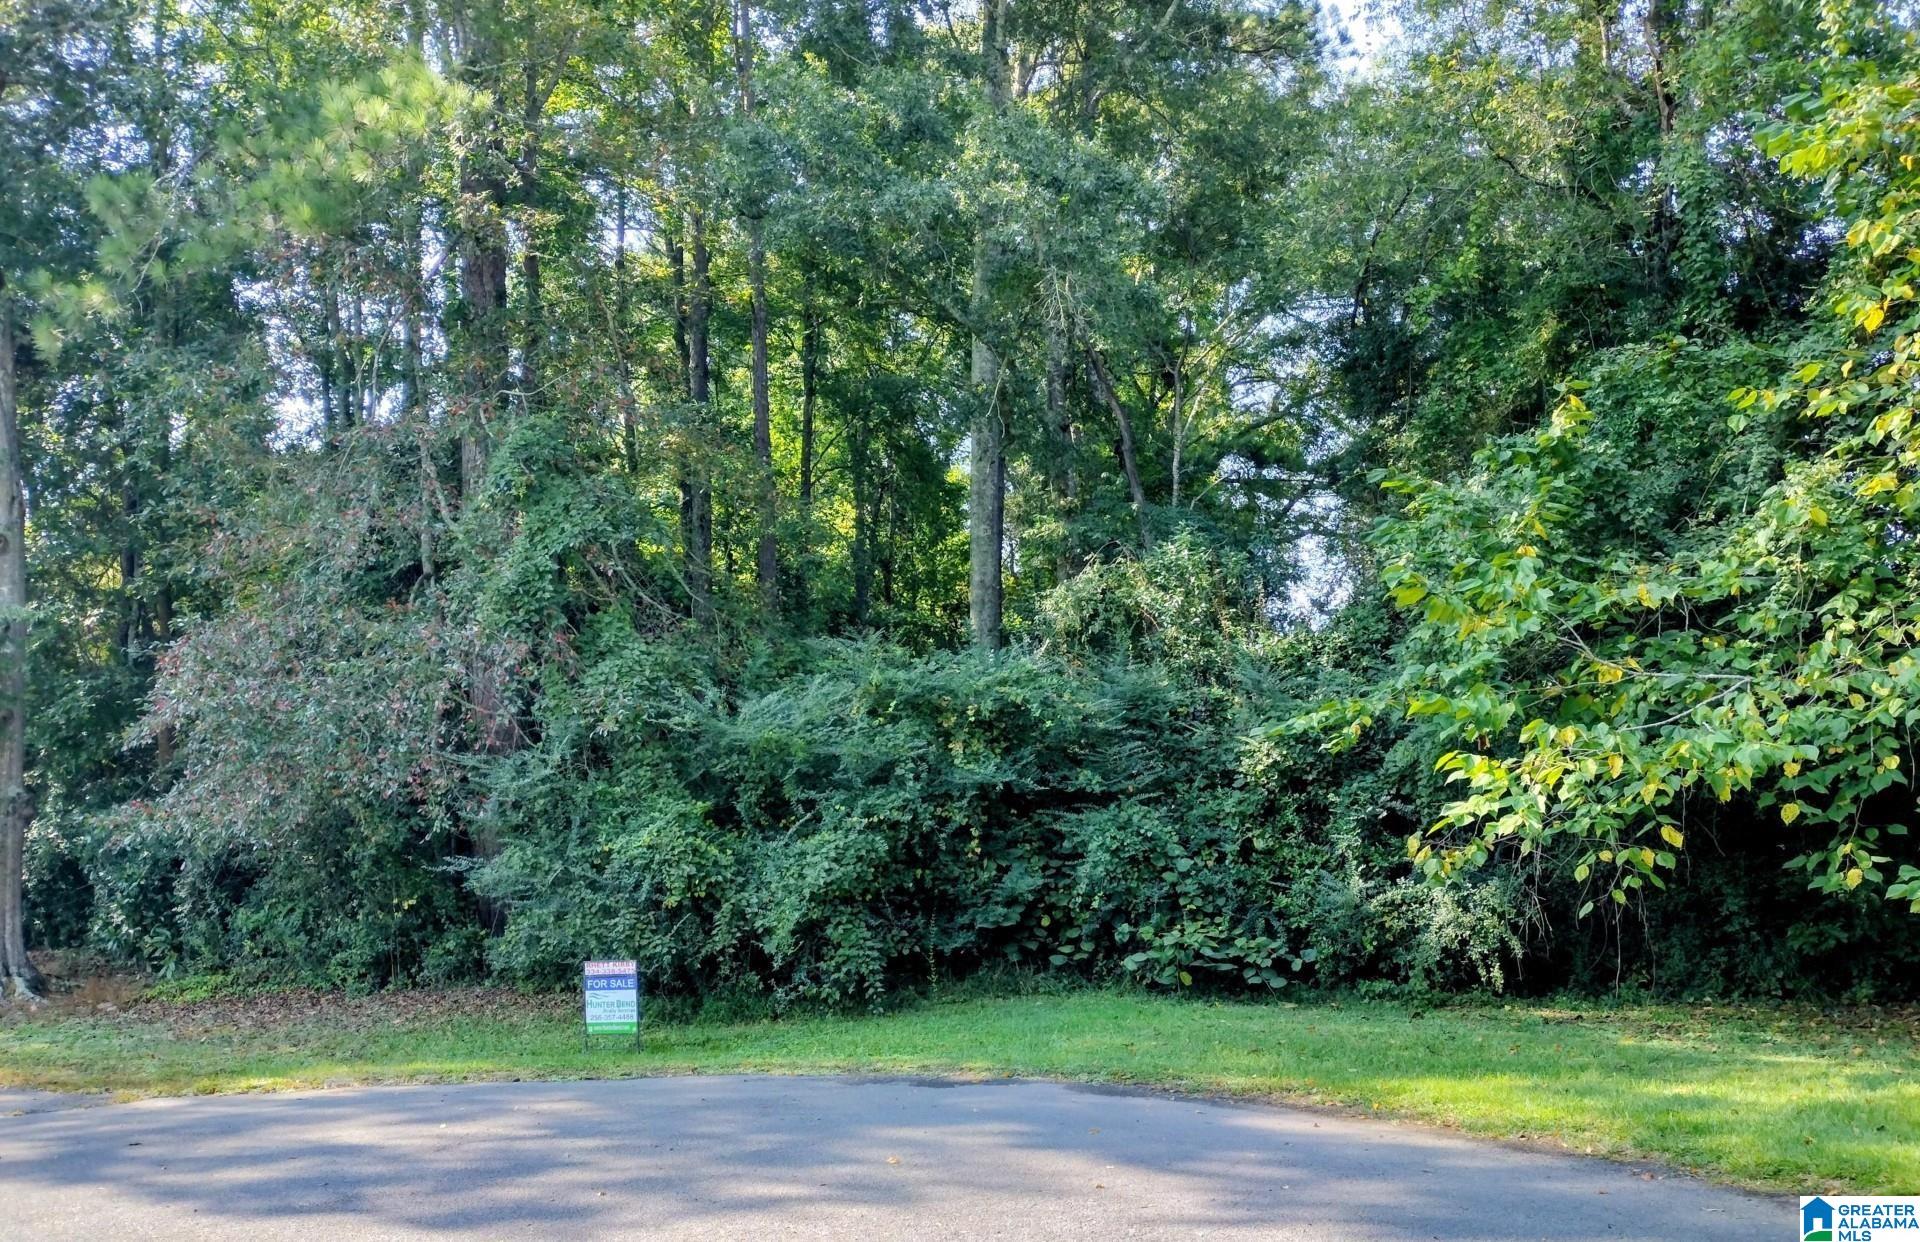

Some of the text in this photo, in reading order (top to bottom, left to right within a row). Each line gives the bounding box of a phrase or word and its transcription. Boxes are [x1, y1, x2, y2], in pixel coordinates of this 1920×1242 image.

[587, 979, 634, 989] FOR SALE
[587, 1000, 635, 1008] HUNTER BEND
